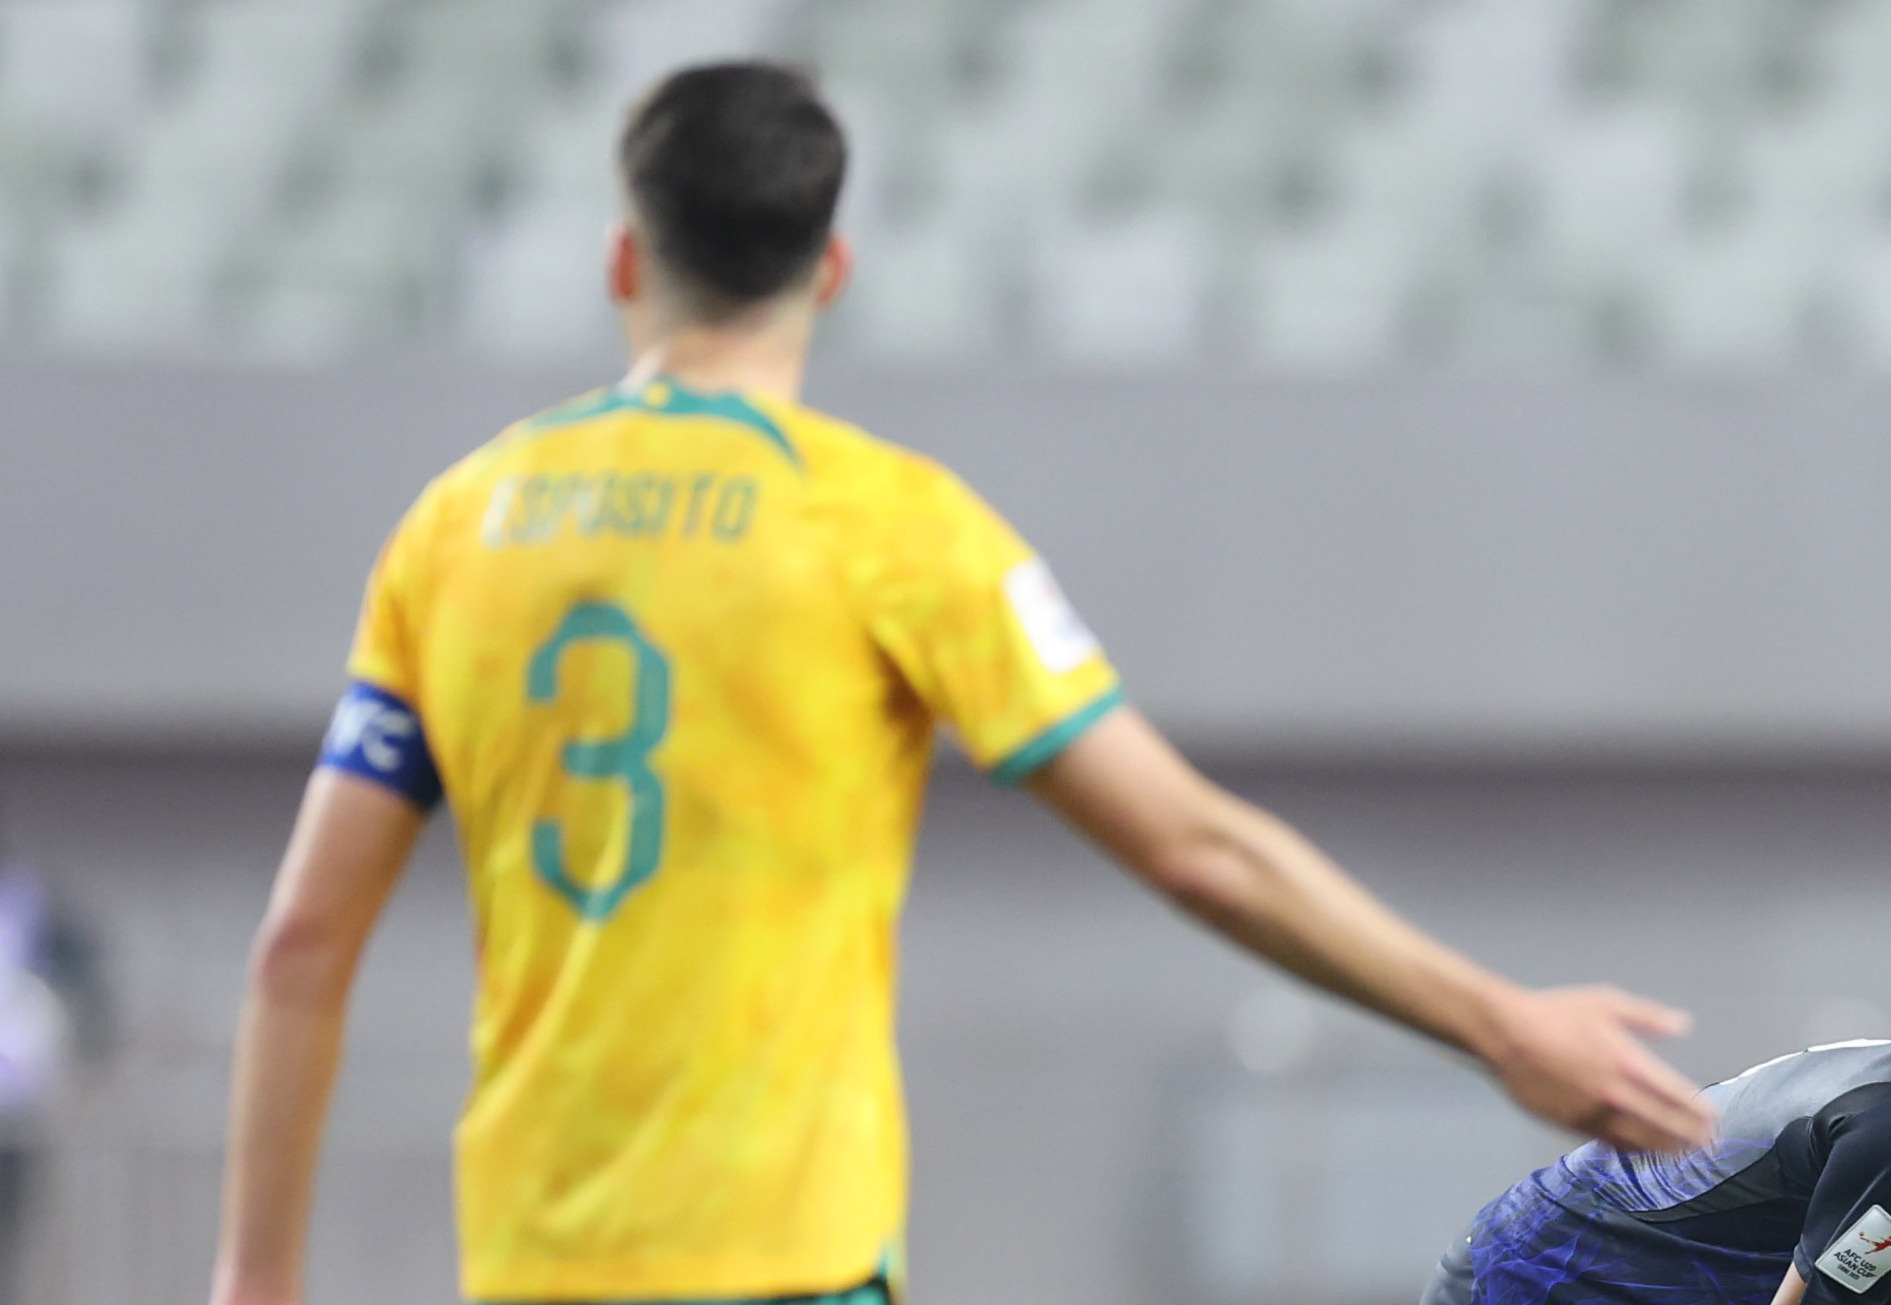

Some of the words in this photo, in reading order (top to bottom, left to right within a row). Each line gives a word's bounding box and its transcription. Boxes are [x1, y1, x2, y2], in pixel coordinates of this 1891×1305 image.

[525, 597, 672, 926] 3
[1833, 1251, 1859, 1271] ASIAN
[1856, 1267, 1877, 1279] CUP
[1843, 1248, 1862, 1263] AFC
